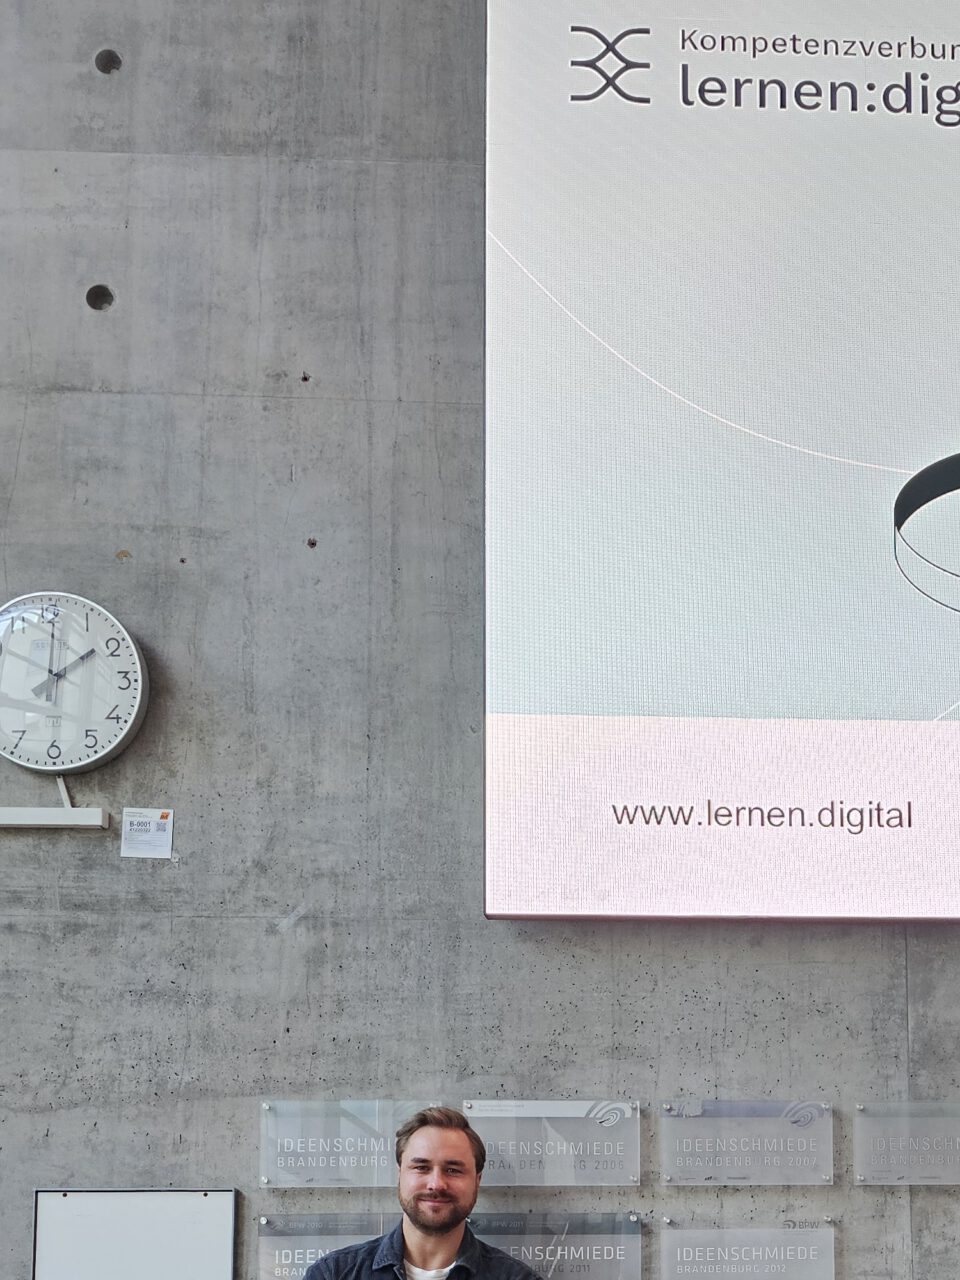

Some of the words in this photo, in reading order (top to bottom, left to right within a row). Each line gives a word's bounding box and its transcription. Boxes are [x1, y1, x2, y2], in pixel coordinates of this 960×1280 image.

[105, 637, 121, 657] 2
[117, 670, 132, 690] 3
[105, 704, 122, 724] 4
[12, 729, 27, 749] 7
[84, 729, 98, 748] 5
[47, 739, 62, 759] 6
[612, 799, 913, 835] www.lernen.digital
[277, 1138, 391, 1152] IDEENSCHMI
[486, 1141, 625, 1156] DEENSCHMIEDE
[676, 1137, 817, 1152] IDEENSCHMIEDE
[277, 1156, 388, 1168] BRANDENBURG
[788, 1156, 817, 1167] 2007
[798, 1221, 820, 1229] BPW
[510, 1246, 625, 1260] ENSCHMIEDE
[677, 1246, 818, 1261] IDEENSCHMIEDE
[570, 1264, 591, 1273] 2011
[677, 1264, 760, 1274] BRANDENBURG
[764, 1264, 786, 1273] 2012
